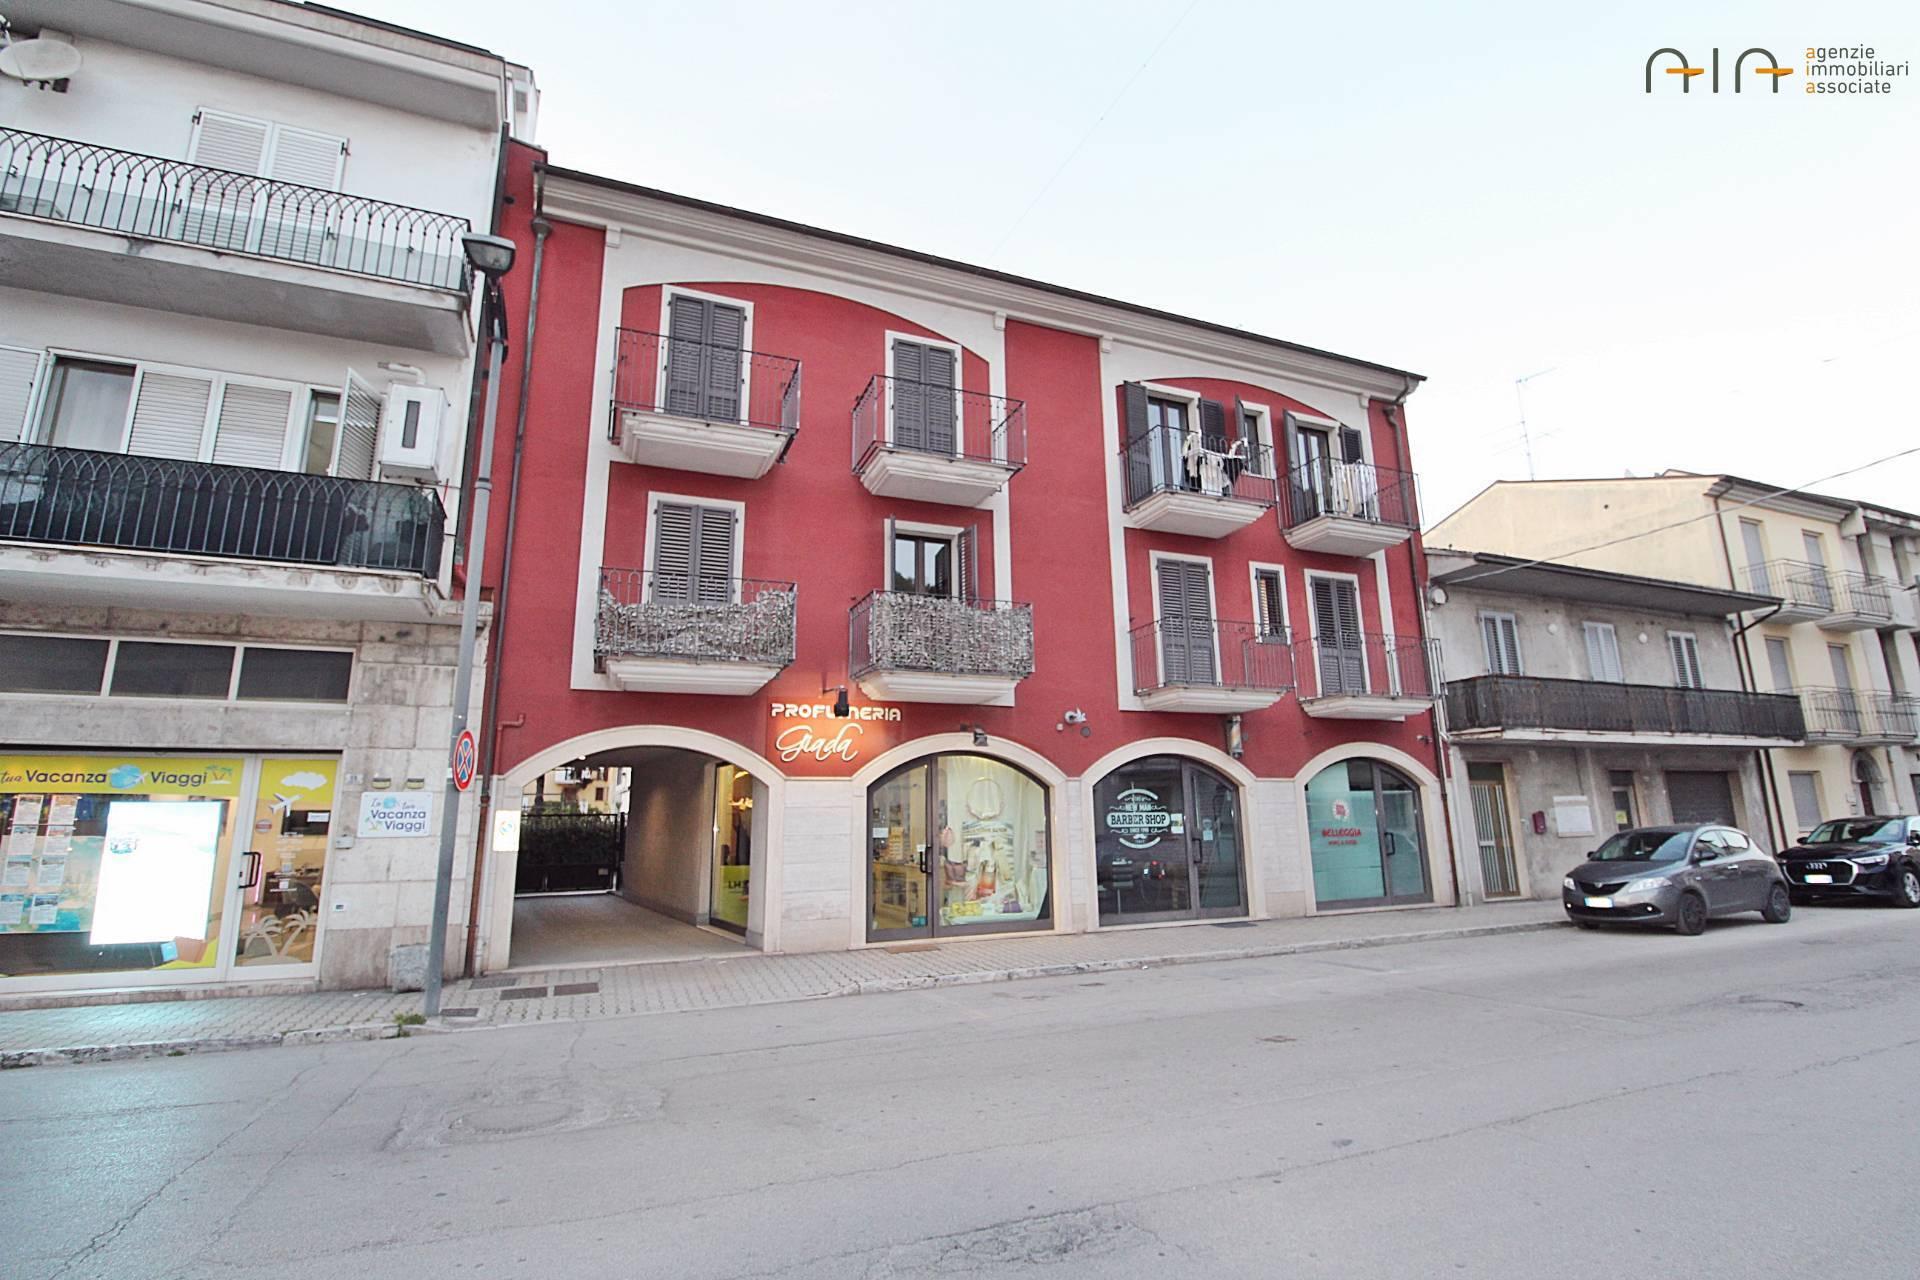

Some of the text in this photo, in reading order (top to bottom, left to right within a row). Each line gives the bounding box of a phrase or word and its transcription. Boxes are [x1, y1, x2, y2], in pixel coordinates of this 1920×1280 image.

[776, 722, 863, 762] Giada
[25, 769, 107, 784] Vacanza
[151, 770, 207, 787] Viaggi
[371, 809, 427, 820] Vacanza
[1111, 814, 1167, 825] BARBER SHOP
[384, 820, 426, 833] Viaggi
